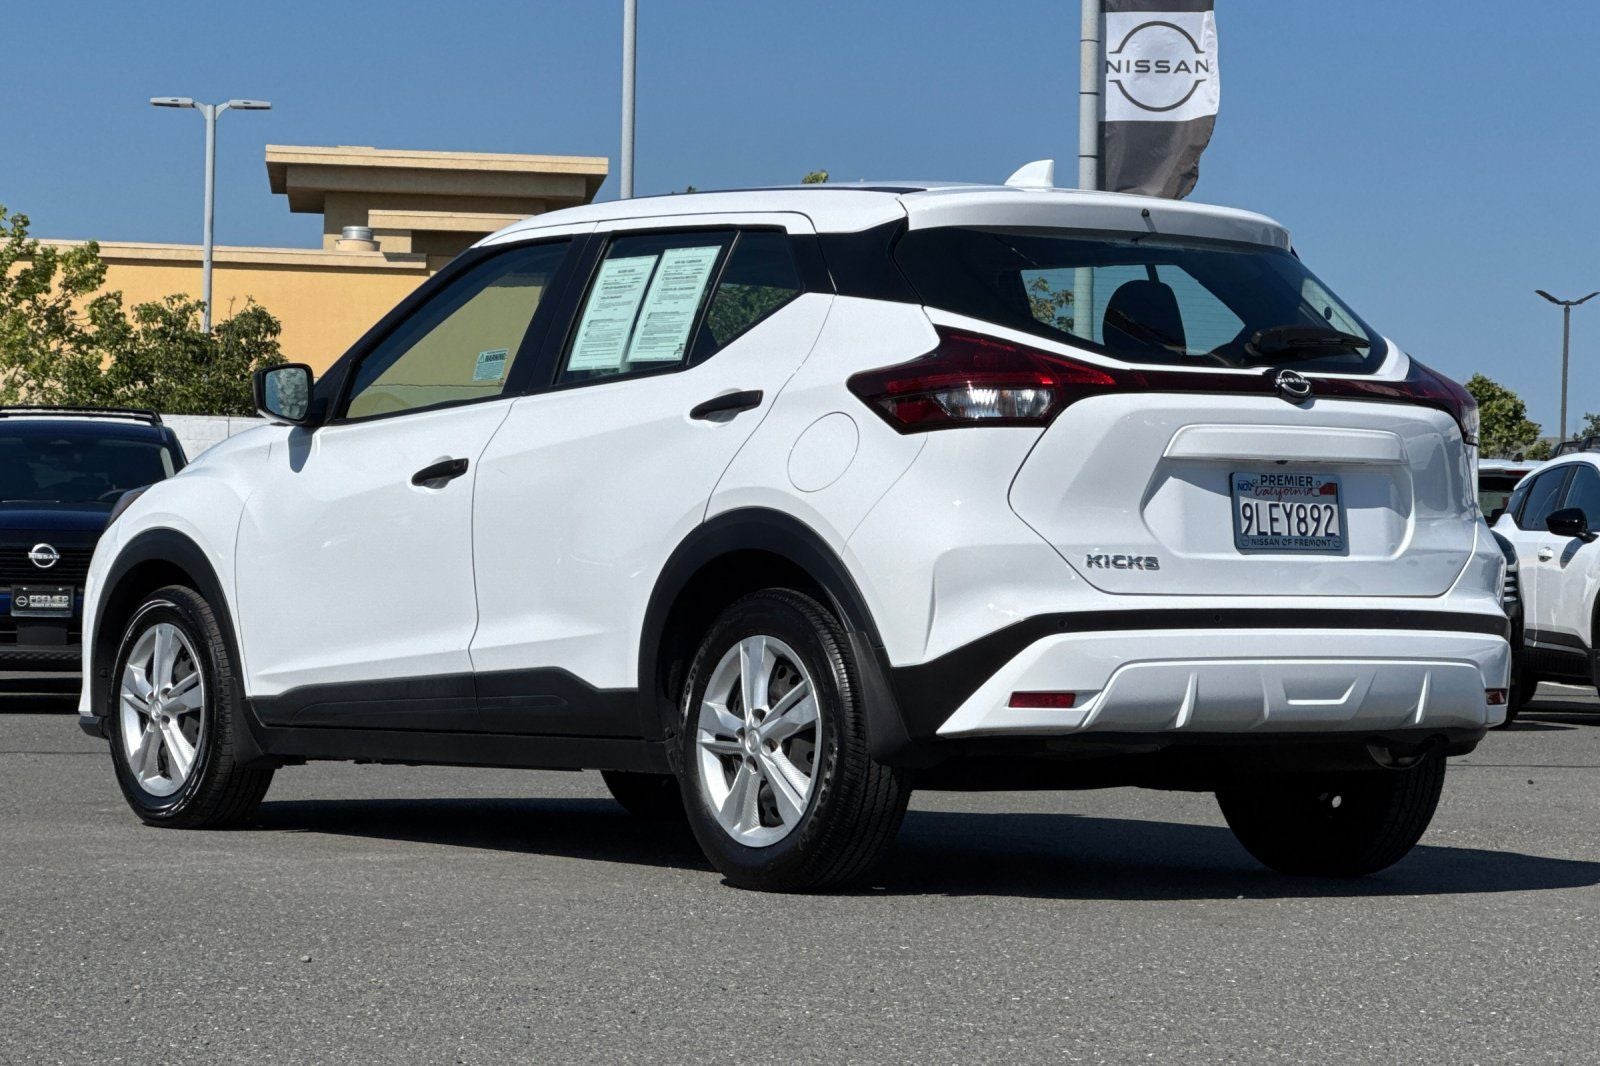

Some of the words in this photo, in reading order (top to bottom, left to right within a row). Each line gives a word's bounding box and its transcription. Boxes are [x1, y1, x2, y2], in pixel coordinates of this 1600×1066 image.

[1105, 59, 1209, 74] NISSAN
[1260, 474, 1313, 487] PREMIER
[1241, 502, 1336, 537] 9LEY892
[1251, 538, 1279, 546] NISSAN
[1294, 539, 1332, 547] FREMONT
[1086, 554, 1160, 570] KICKS
